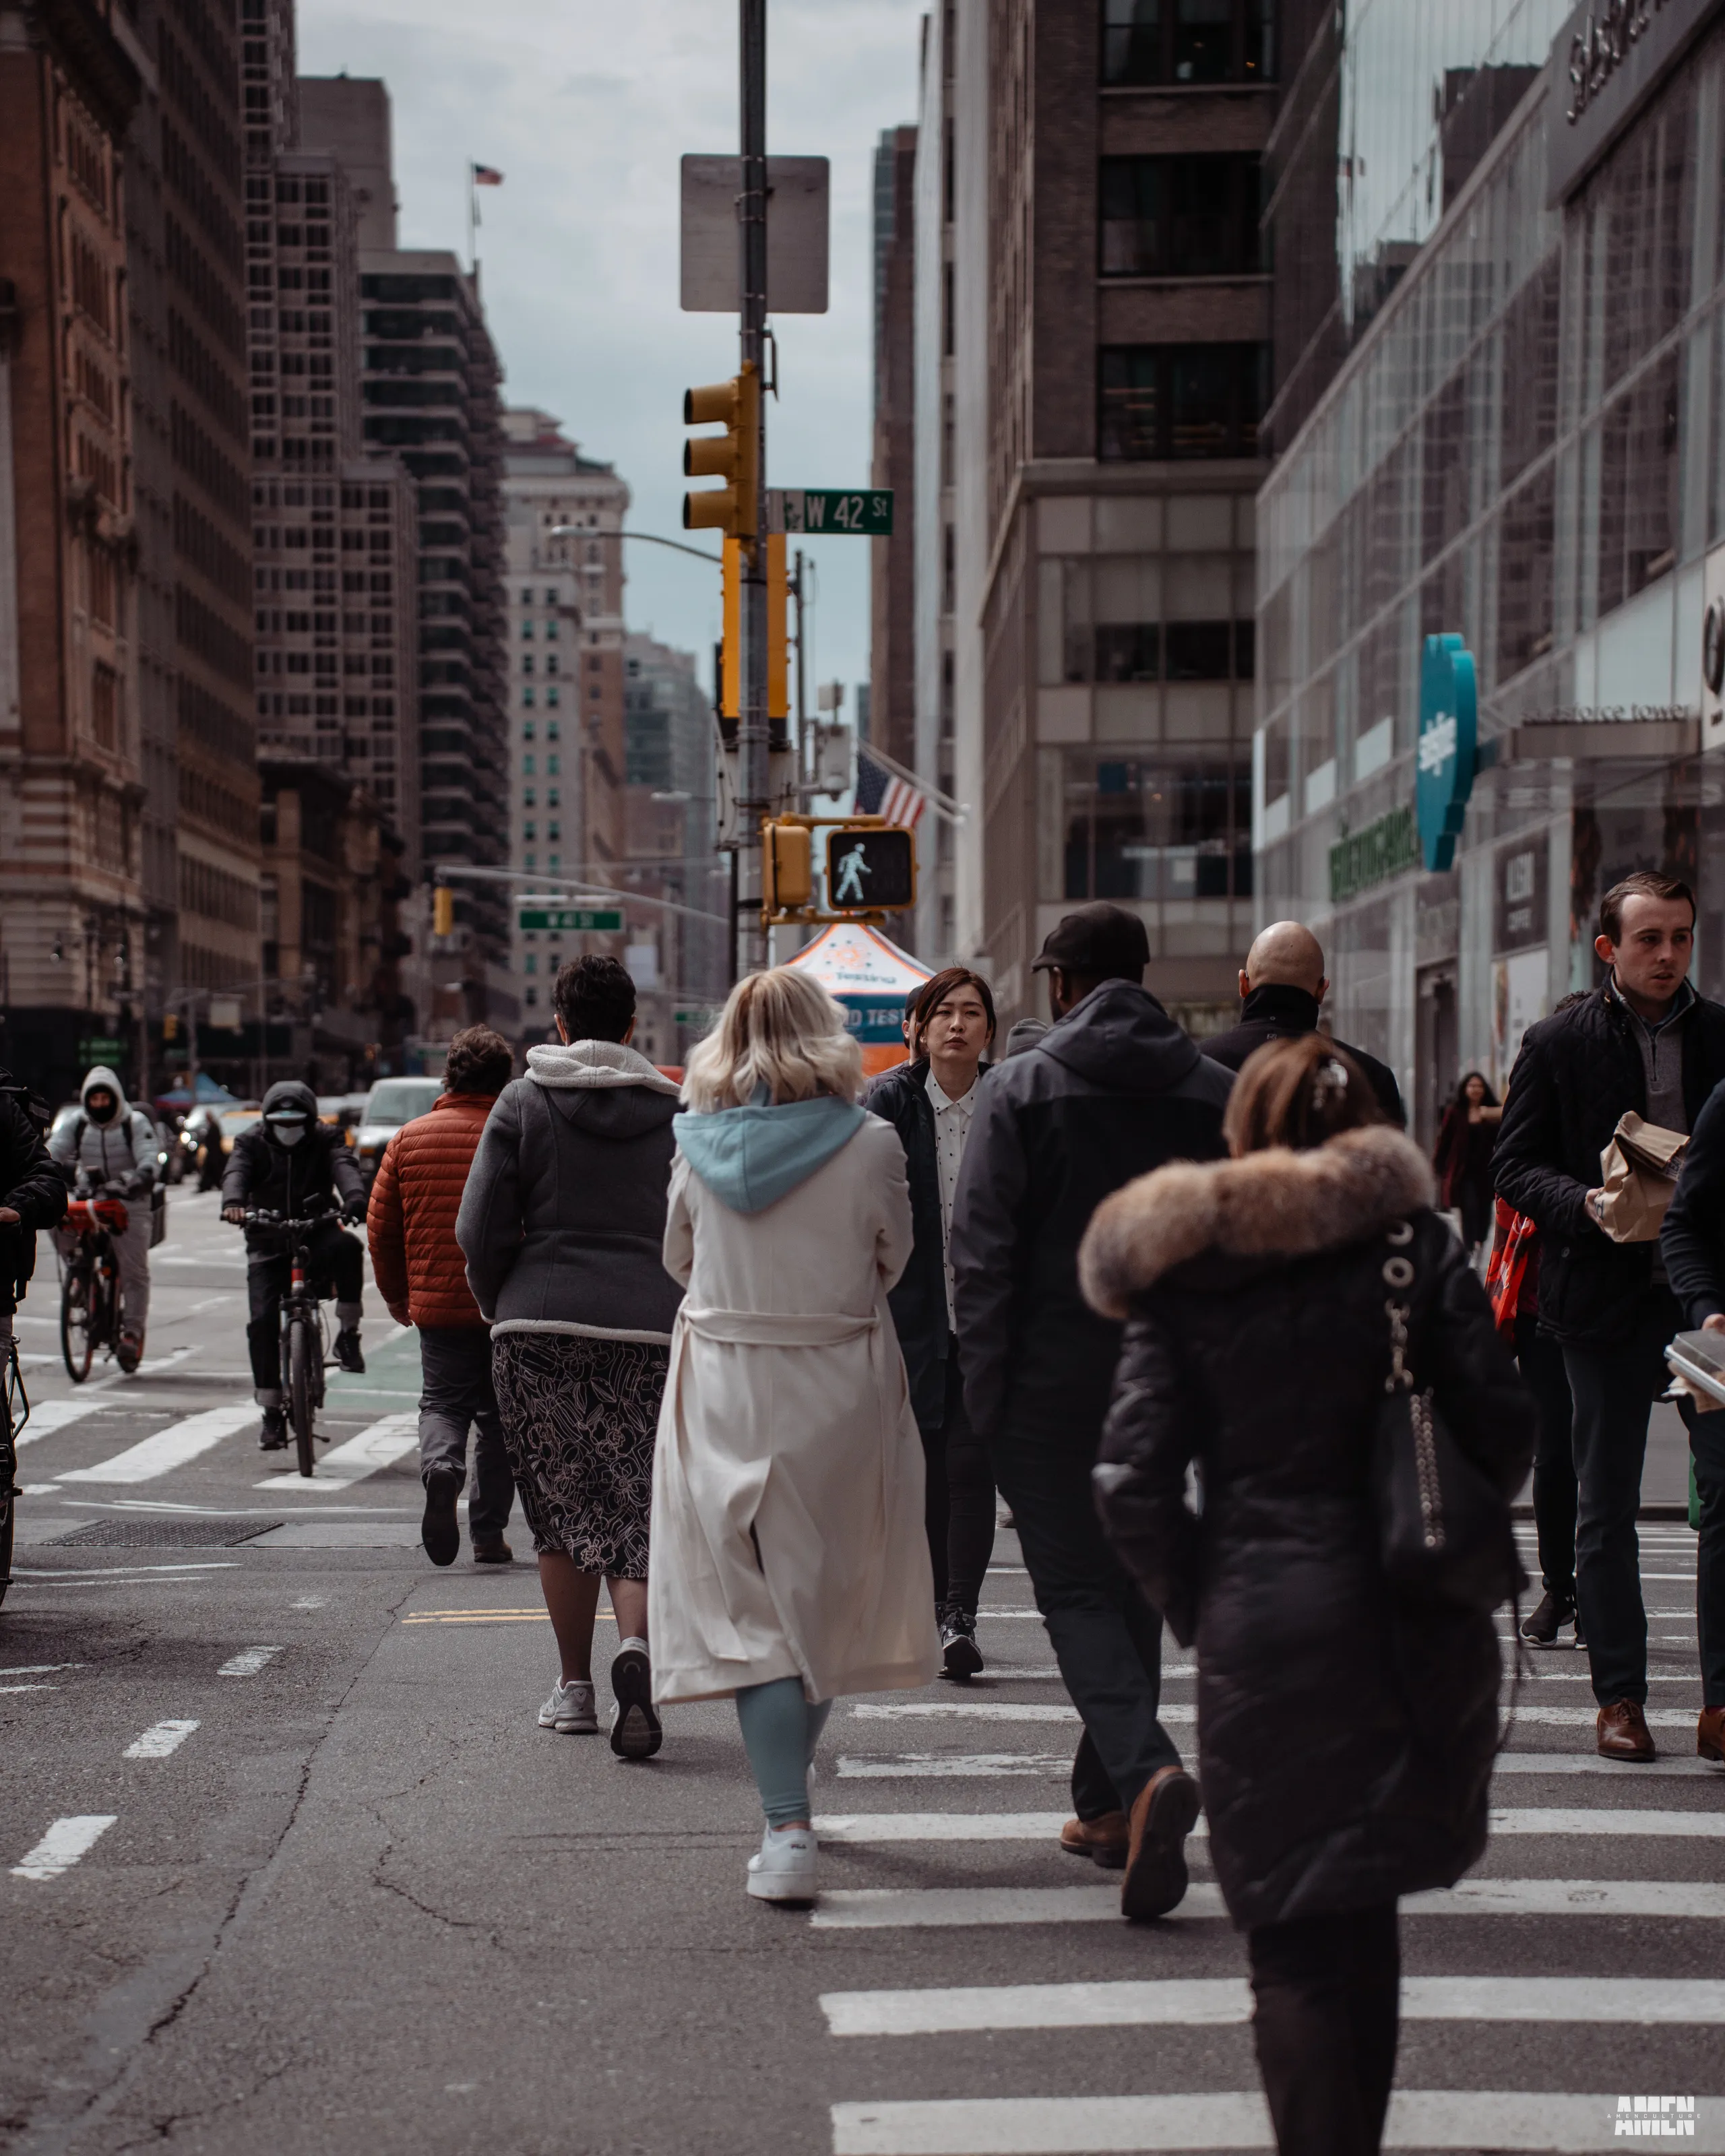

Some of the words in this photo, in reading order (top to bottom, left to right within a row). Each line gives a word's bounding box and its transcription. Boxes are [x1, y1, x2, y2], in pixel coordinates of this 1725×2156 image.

[807, 496, 825, 528] W
[834, 496, 865, 528] 42
[873, 497, 887, 517] St
